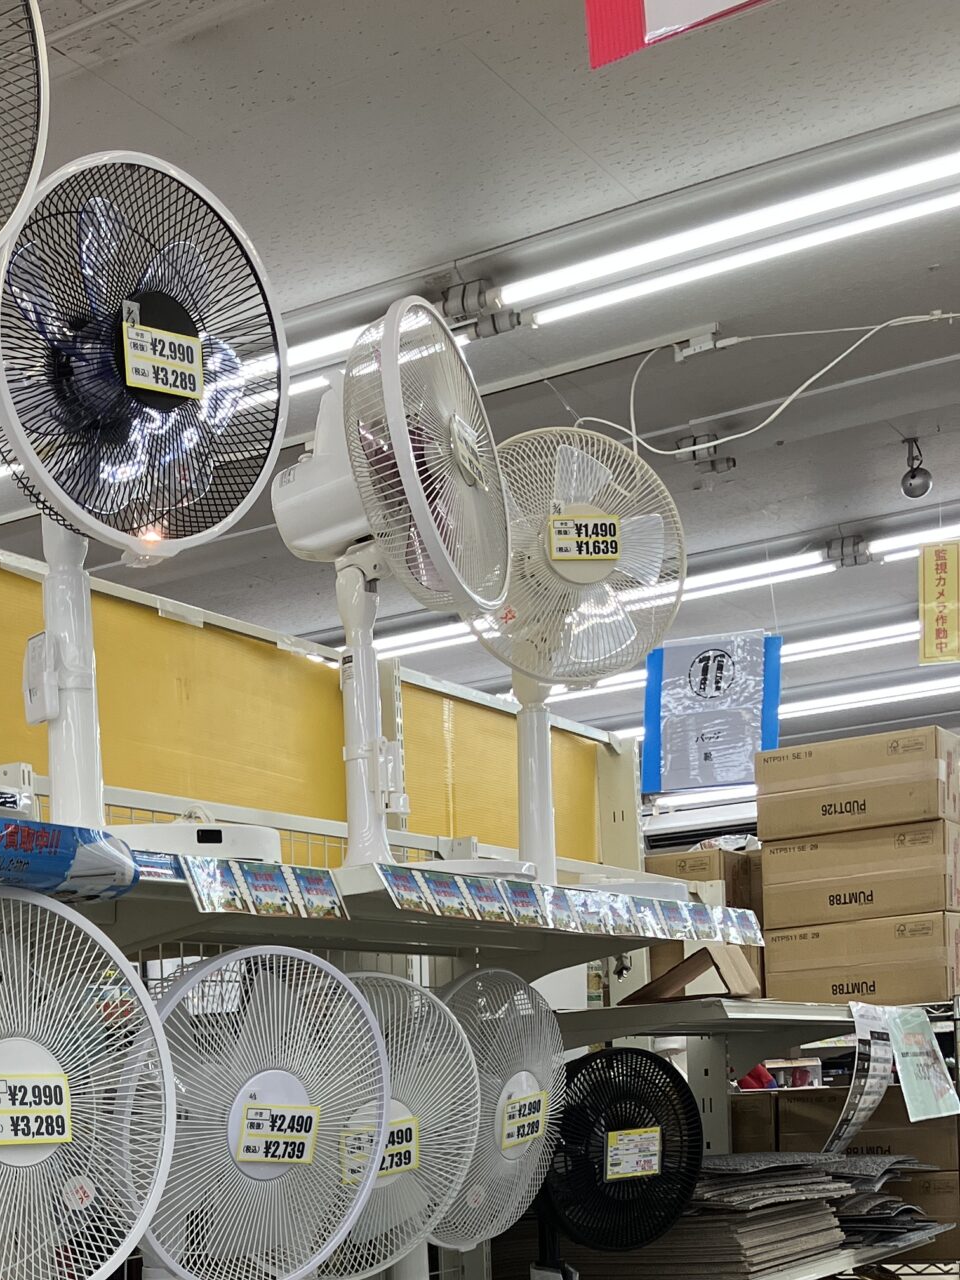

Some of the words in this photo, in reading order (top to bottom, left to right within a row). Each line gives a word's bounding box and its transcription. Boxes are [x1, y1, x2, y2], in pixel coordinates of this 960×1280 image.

[150, 337, 194, 364] ¥2,990
[152, 365, 196, 392] ¥3,289
[575, 523, 617, 538] ¥1,490
[576, 540, 618, 555] ¥1,639
[934, 549, 948, 653] 監視カメラ作動中
[821, 799, 867, 817] PUDT126
[828, 890, 874, 907] PUMT88
[831, 980, 876, 997] PUMT88
[8, 1085, 63, 1108] ¥2,990
[518, 1099, 541, 1118] ¥2,990
[10, 1115, 66, 1138] ¥3,289
[269, 1113, 313, 1135] ¥2,490
[517, 1119, 540, 1139] ¥3,289
[263, 1140, 306, 1161] ¥2,739
